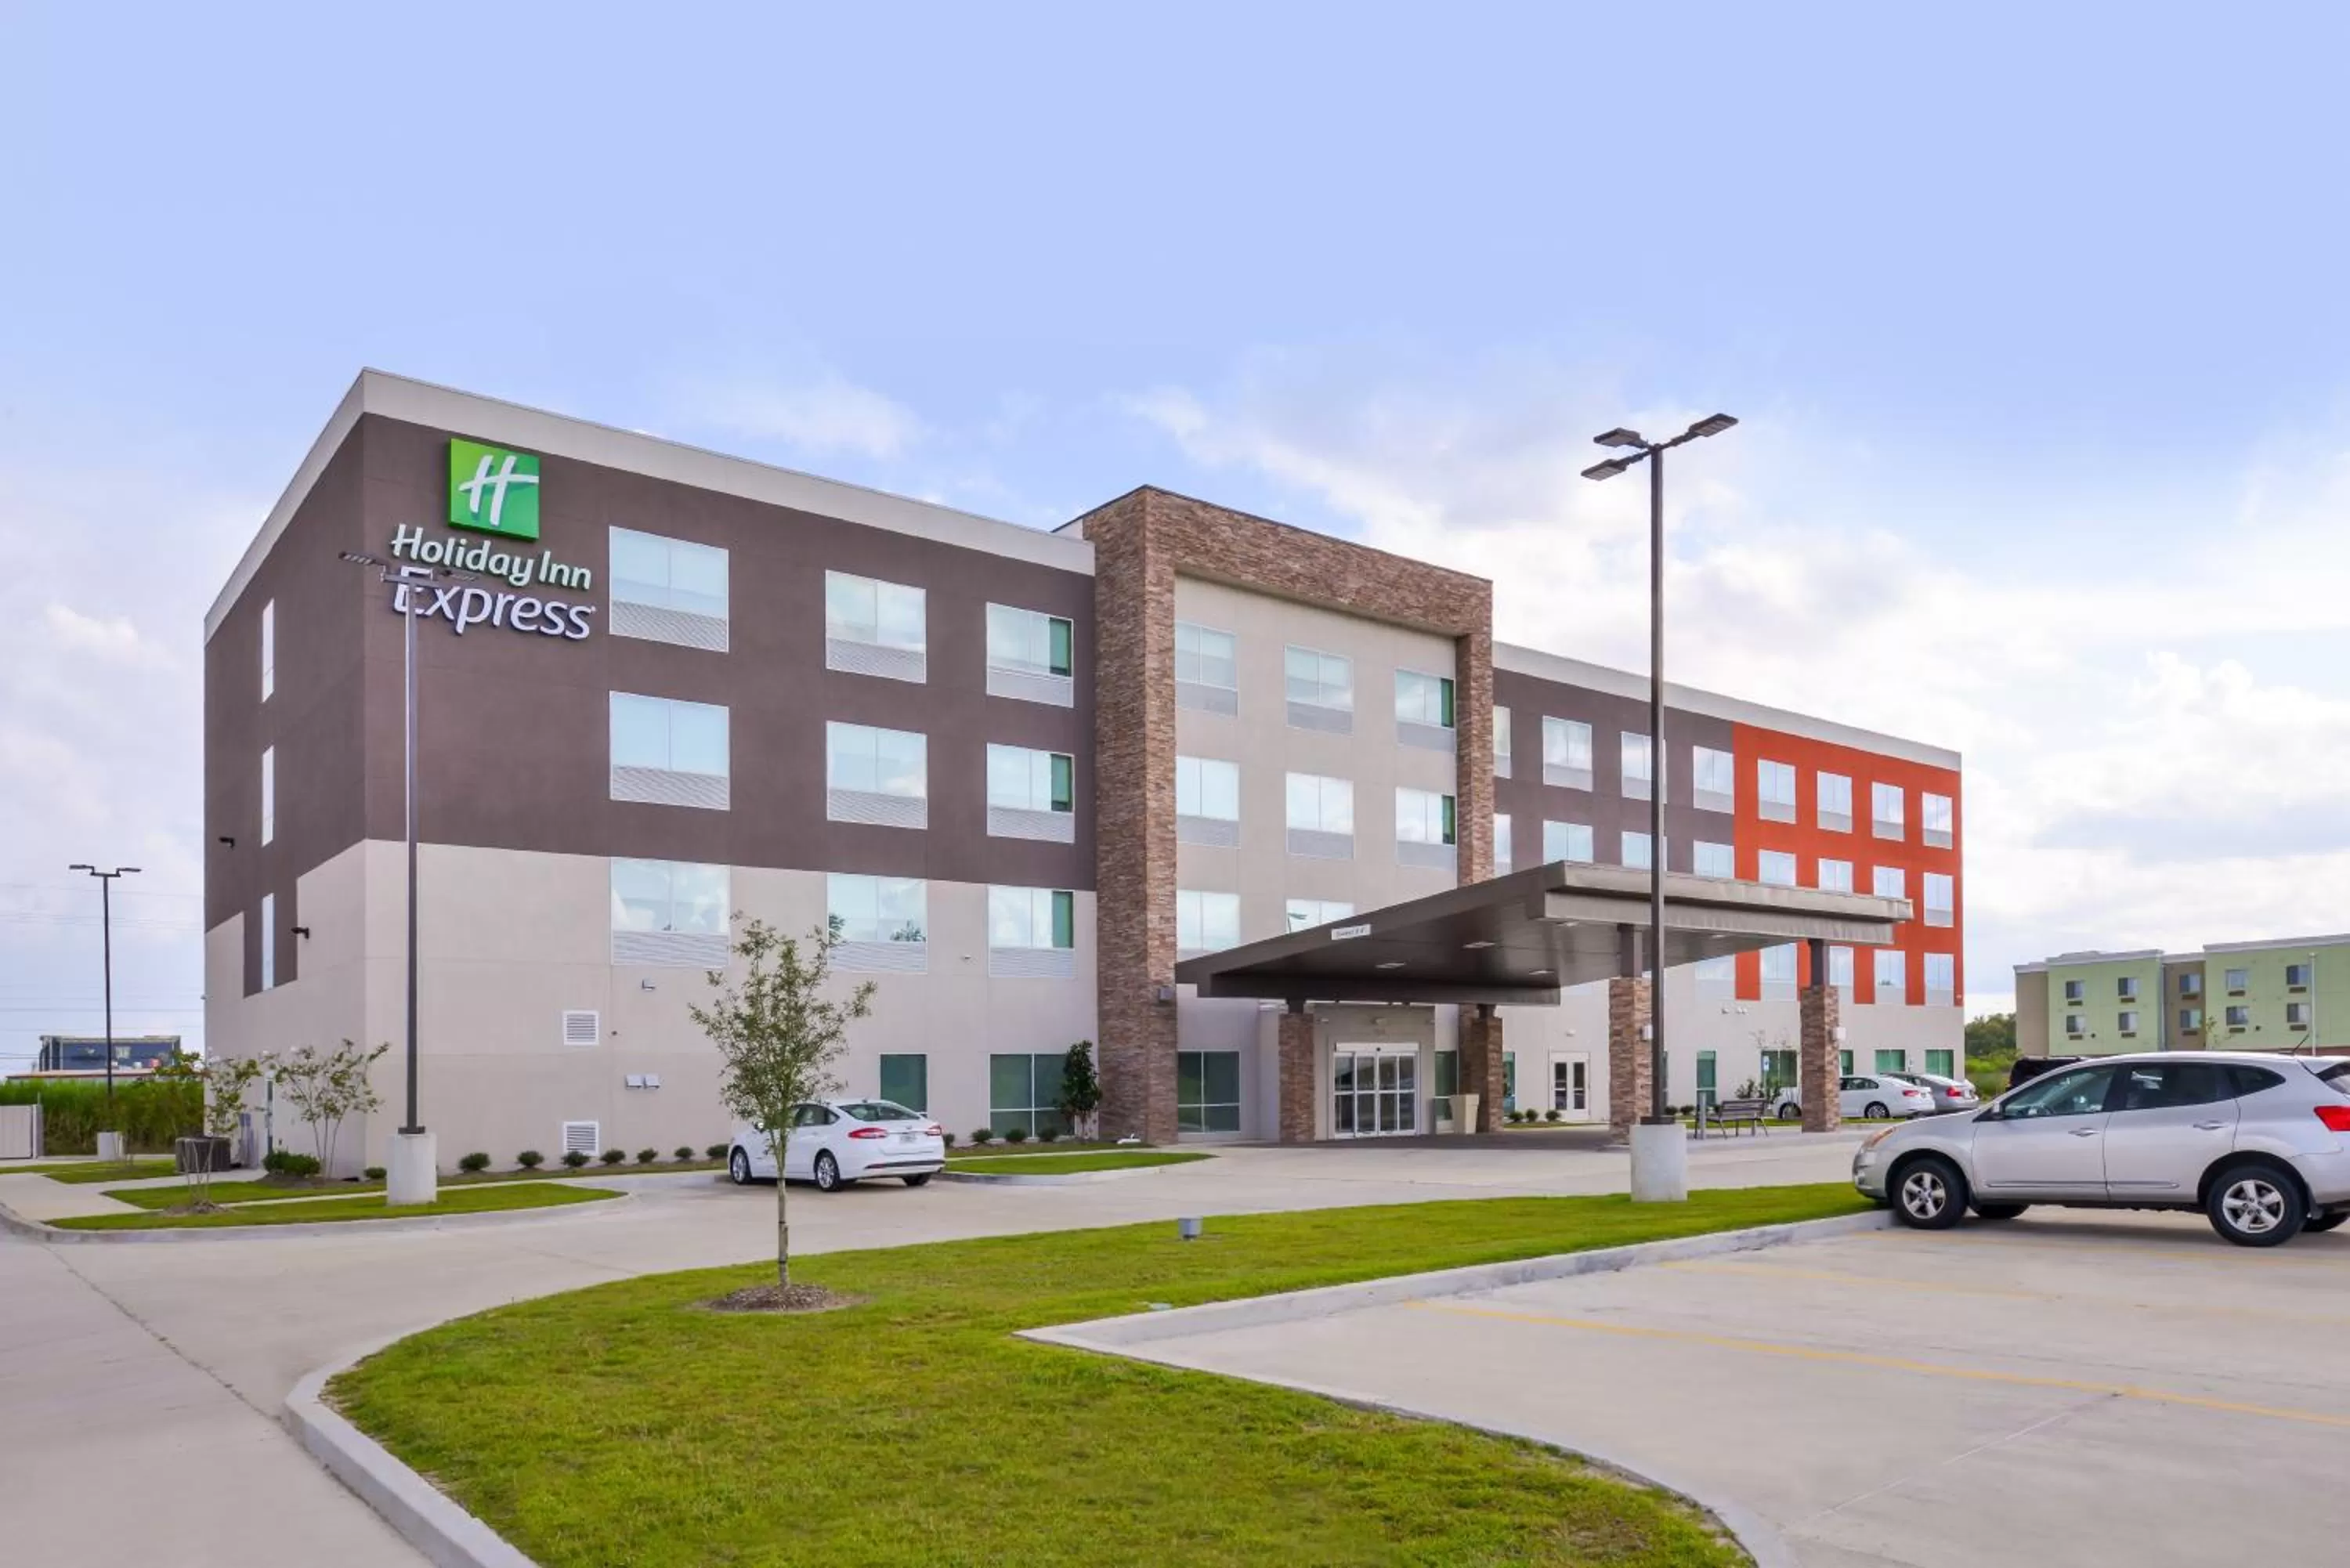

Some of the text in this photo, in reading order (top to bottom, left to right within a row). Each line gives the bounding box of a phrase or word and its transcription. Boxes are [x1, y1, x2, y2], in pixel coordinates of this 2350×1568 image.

[390, 523, 591, 589] Holiday Inn
[394, 565, 592, 639] Express
